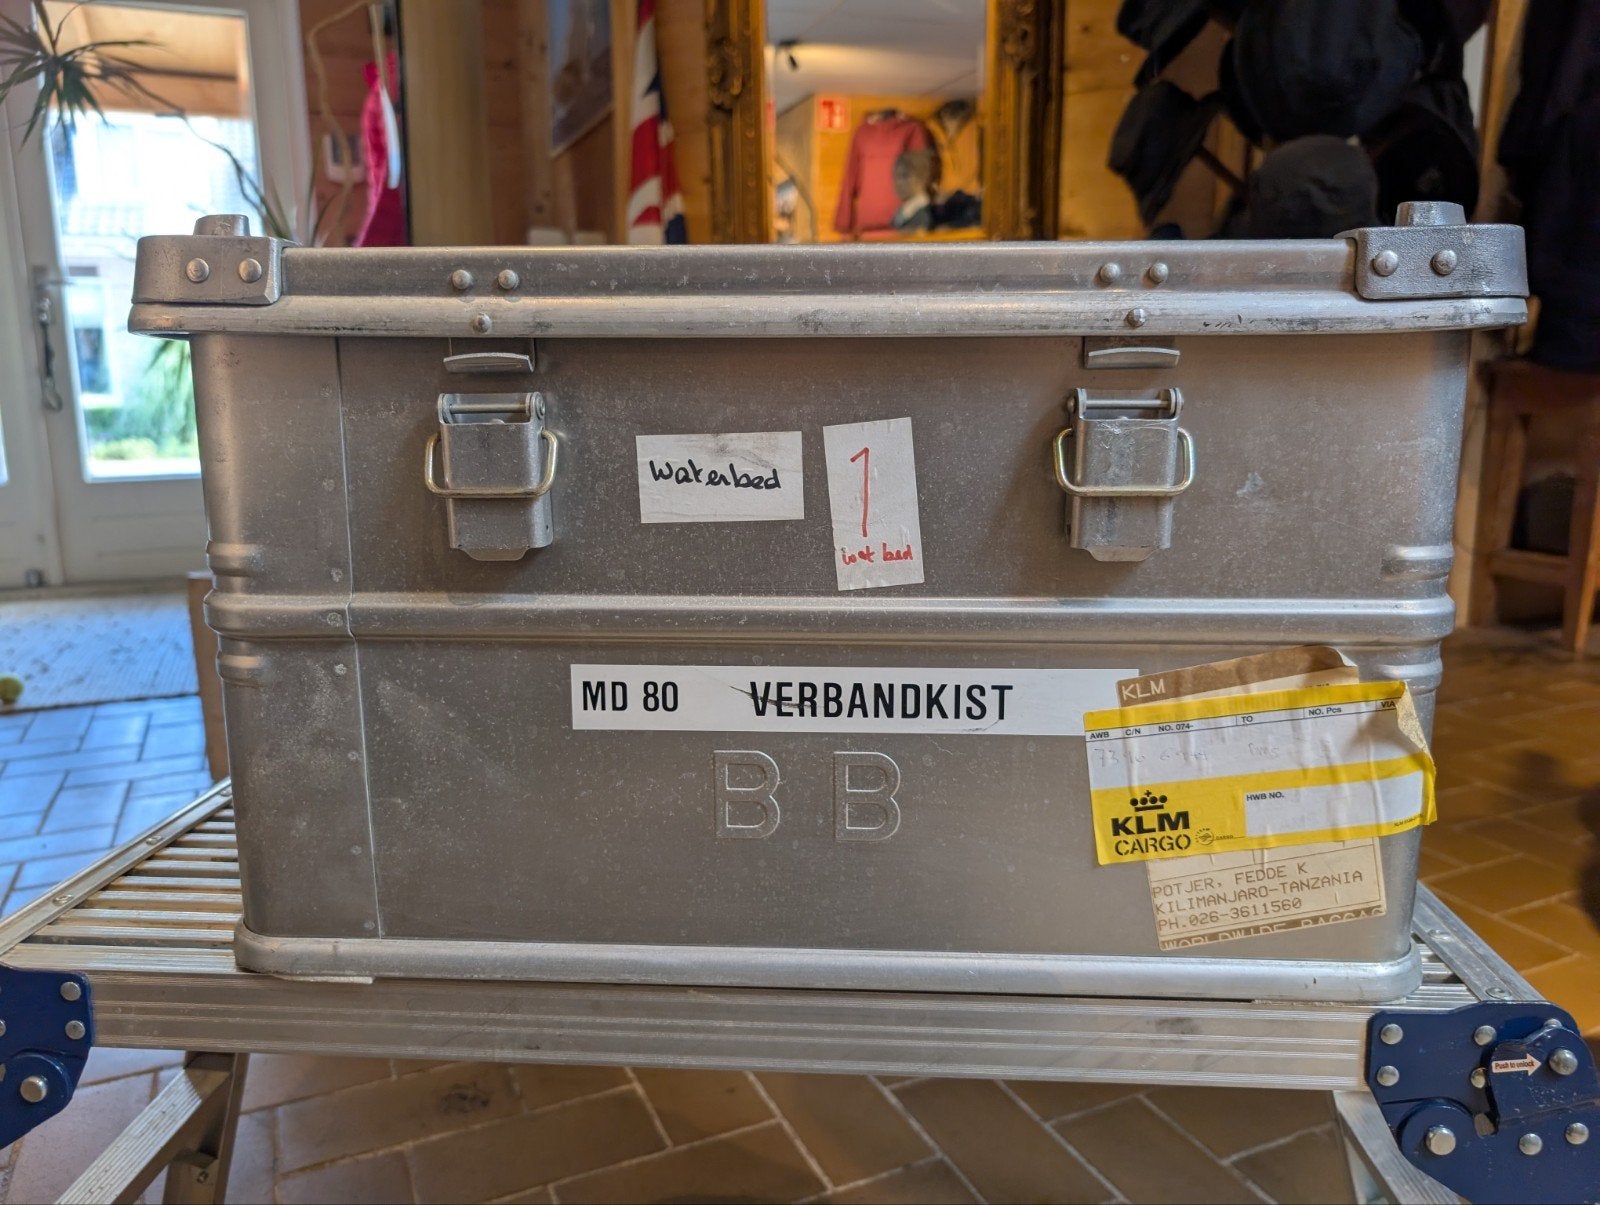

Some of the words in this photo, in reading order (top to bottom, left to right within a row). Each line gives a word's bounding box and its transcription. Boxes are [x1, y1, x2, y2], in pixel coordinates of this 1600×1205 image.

[649, 459, 781, 490] Waterbed
[582, 681, 628, 711] MD
[642, 681, 679, 712] 80
[750, 681, 1014, 721] VERBANDKIST
[1121, 679, 1166, 701] KLM
[1308, 708, 1324, 716] NO.
[1326, 706, 1342, 715] Pcs
[1381, 700, 1396, 709] VIA
[1241, 715, 1254, 724] TO
[1089, 731, 1110, 740] AWB
[1125, 728, 1141, 736] C/N
[1158, 724, 1173, 732] NO.
[713, 750, 781, 839] B
[832, 750, 902, 841] B
[1246, 793, 1267, 802] HWB
[1268, 791, 1285, 799] NO.
[1111, 811, 1191, 837] KLM
[1114, 833, 1192, 856] CARGO
[1152, 877, 1222, 898] POTJER,
[1234, 865, 1288, 885] FEDDE
[1296, 862, 1308, 875] K
[1154, 870, 1364, 915] KILIMANJARO-TANZANIA
[1494, 1061, 1509, 1070] Push
